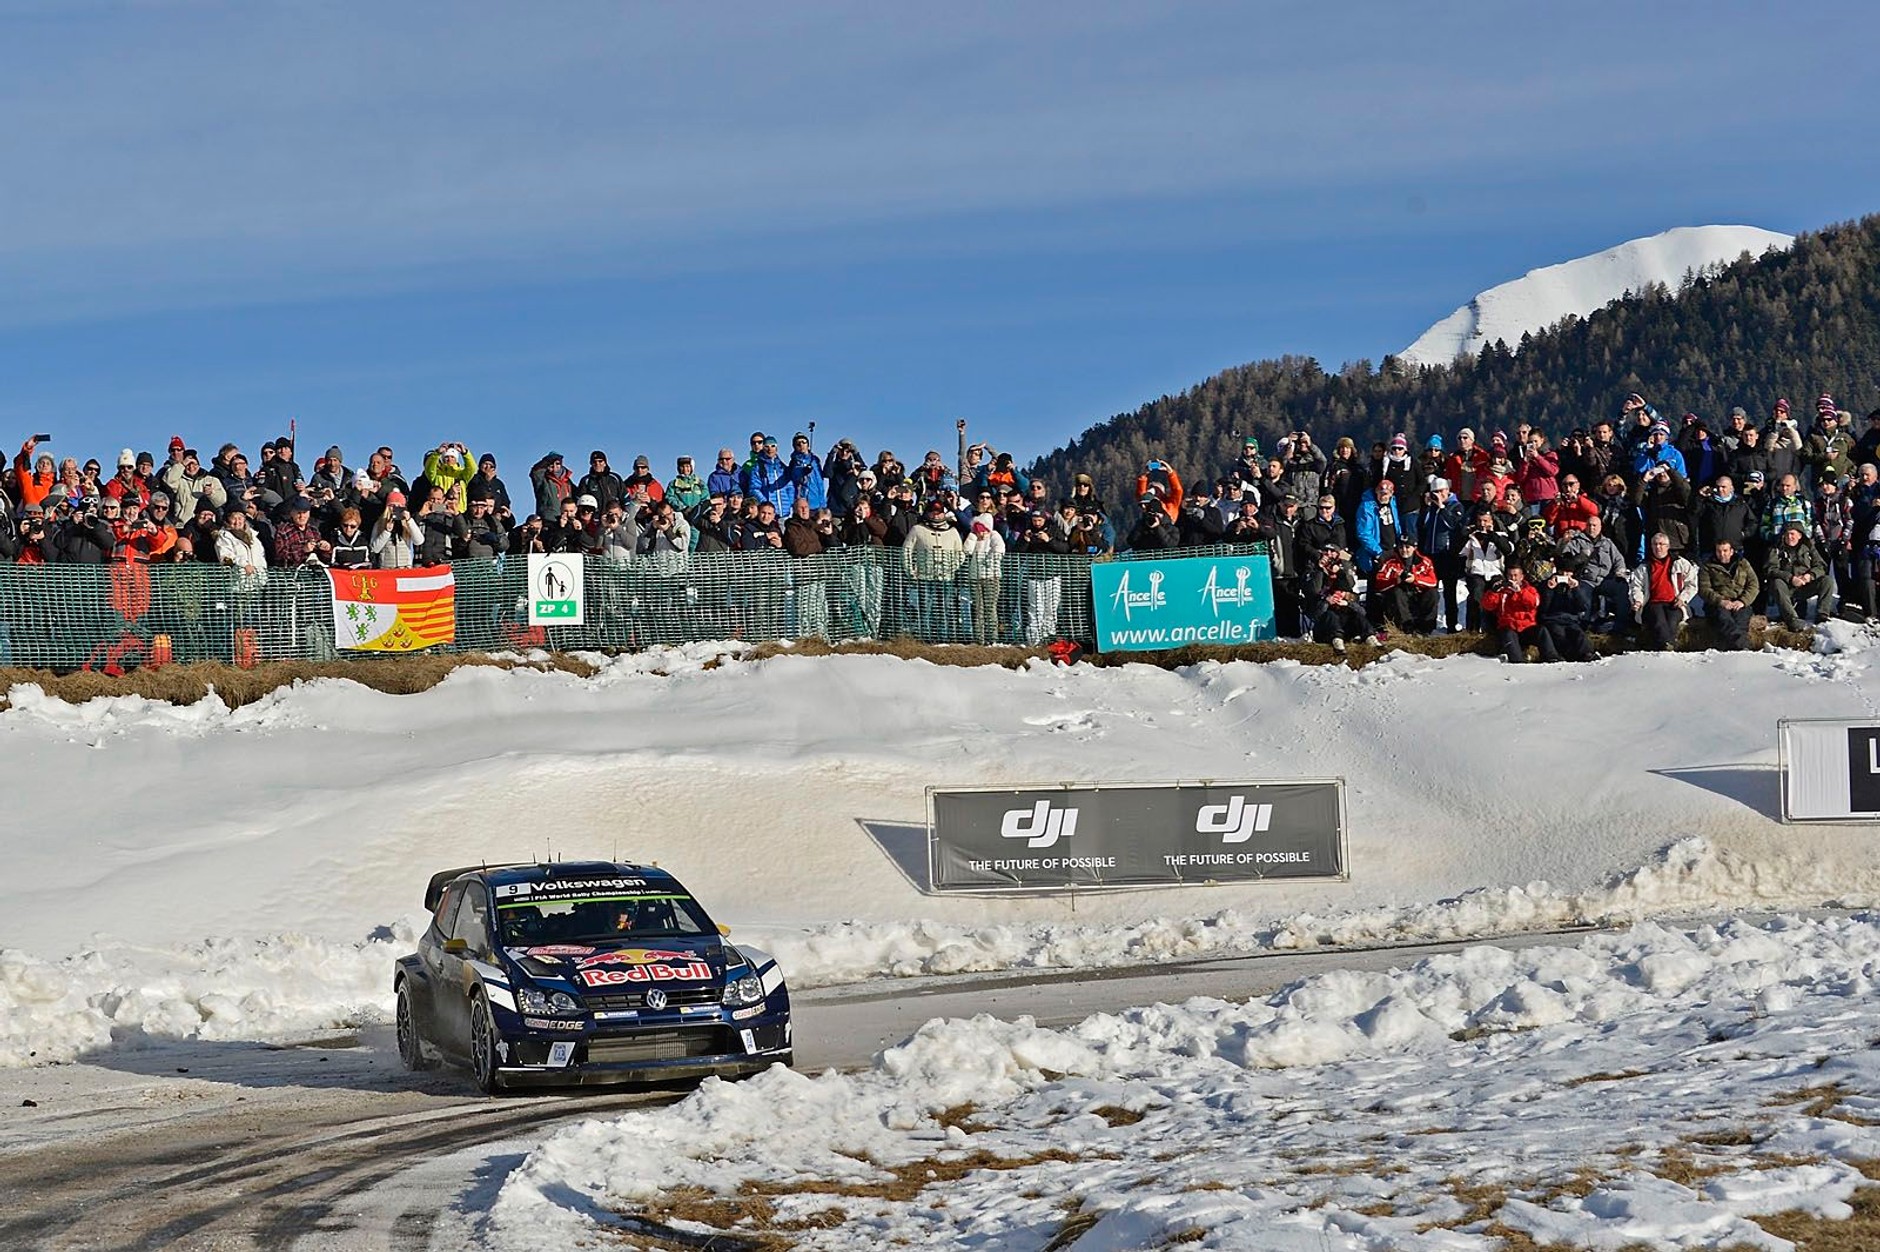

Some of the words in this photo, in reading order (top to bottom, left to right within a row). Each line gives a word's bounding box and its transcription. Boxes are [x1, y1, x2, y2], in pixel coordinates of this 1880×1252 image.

[1110, 570, 1166, 621] Ancelle
[1198, 565, 1253, 617] Ancelle
[539, 604, 556, 614] ZP
[561, 604, 569, 614] 4
[1111, 618, 1267, 644] www.ancelle.fr
[969, 860, 991, 871] THE
[994, 858, 1040, 870] FUTURE
[1042, 858, 1059, 869] OF
[1062, 857, 1116, 868] POSSIBLE
[1164, 855, 1187, 866] THE
[1189, 853, 1234, 865] FUTURE
[1236, 853, 1254, 864] OF
[1256, 851, 1310, 863] POSSIBLE
[509, 885, 518, 894] 9
[531, 878, 647, 891] Volkswagen
[583, 967, 649, 985] Red
[651, 963, 711, 980] Bull
[549, 1020, 585, 1030] EDGE
